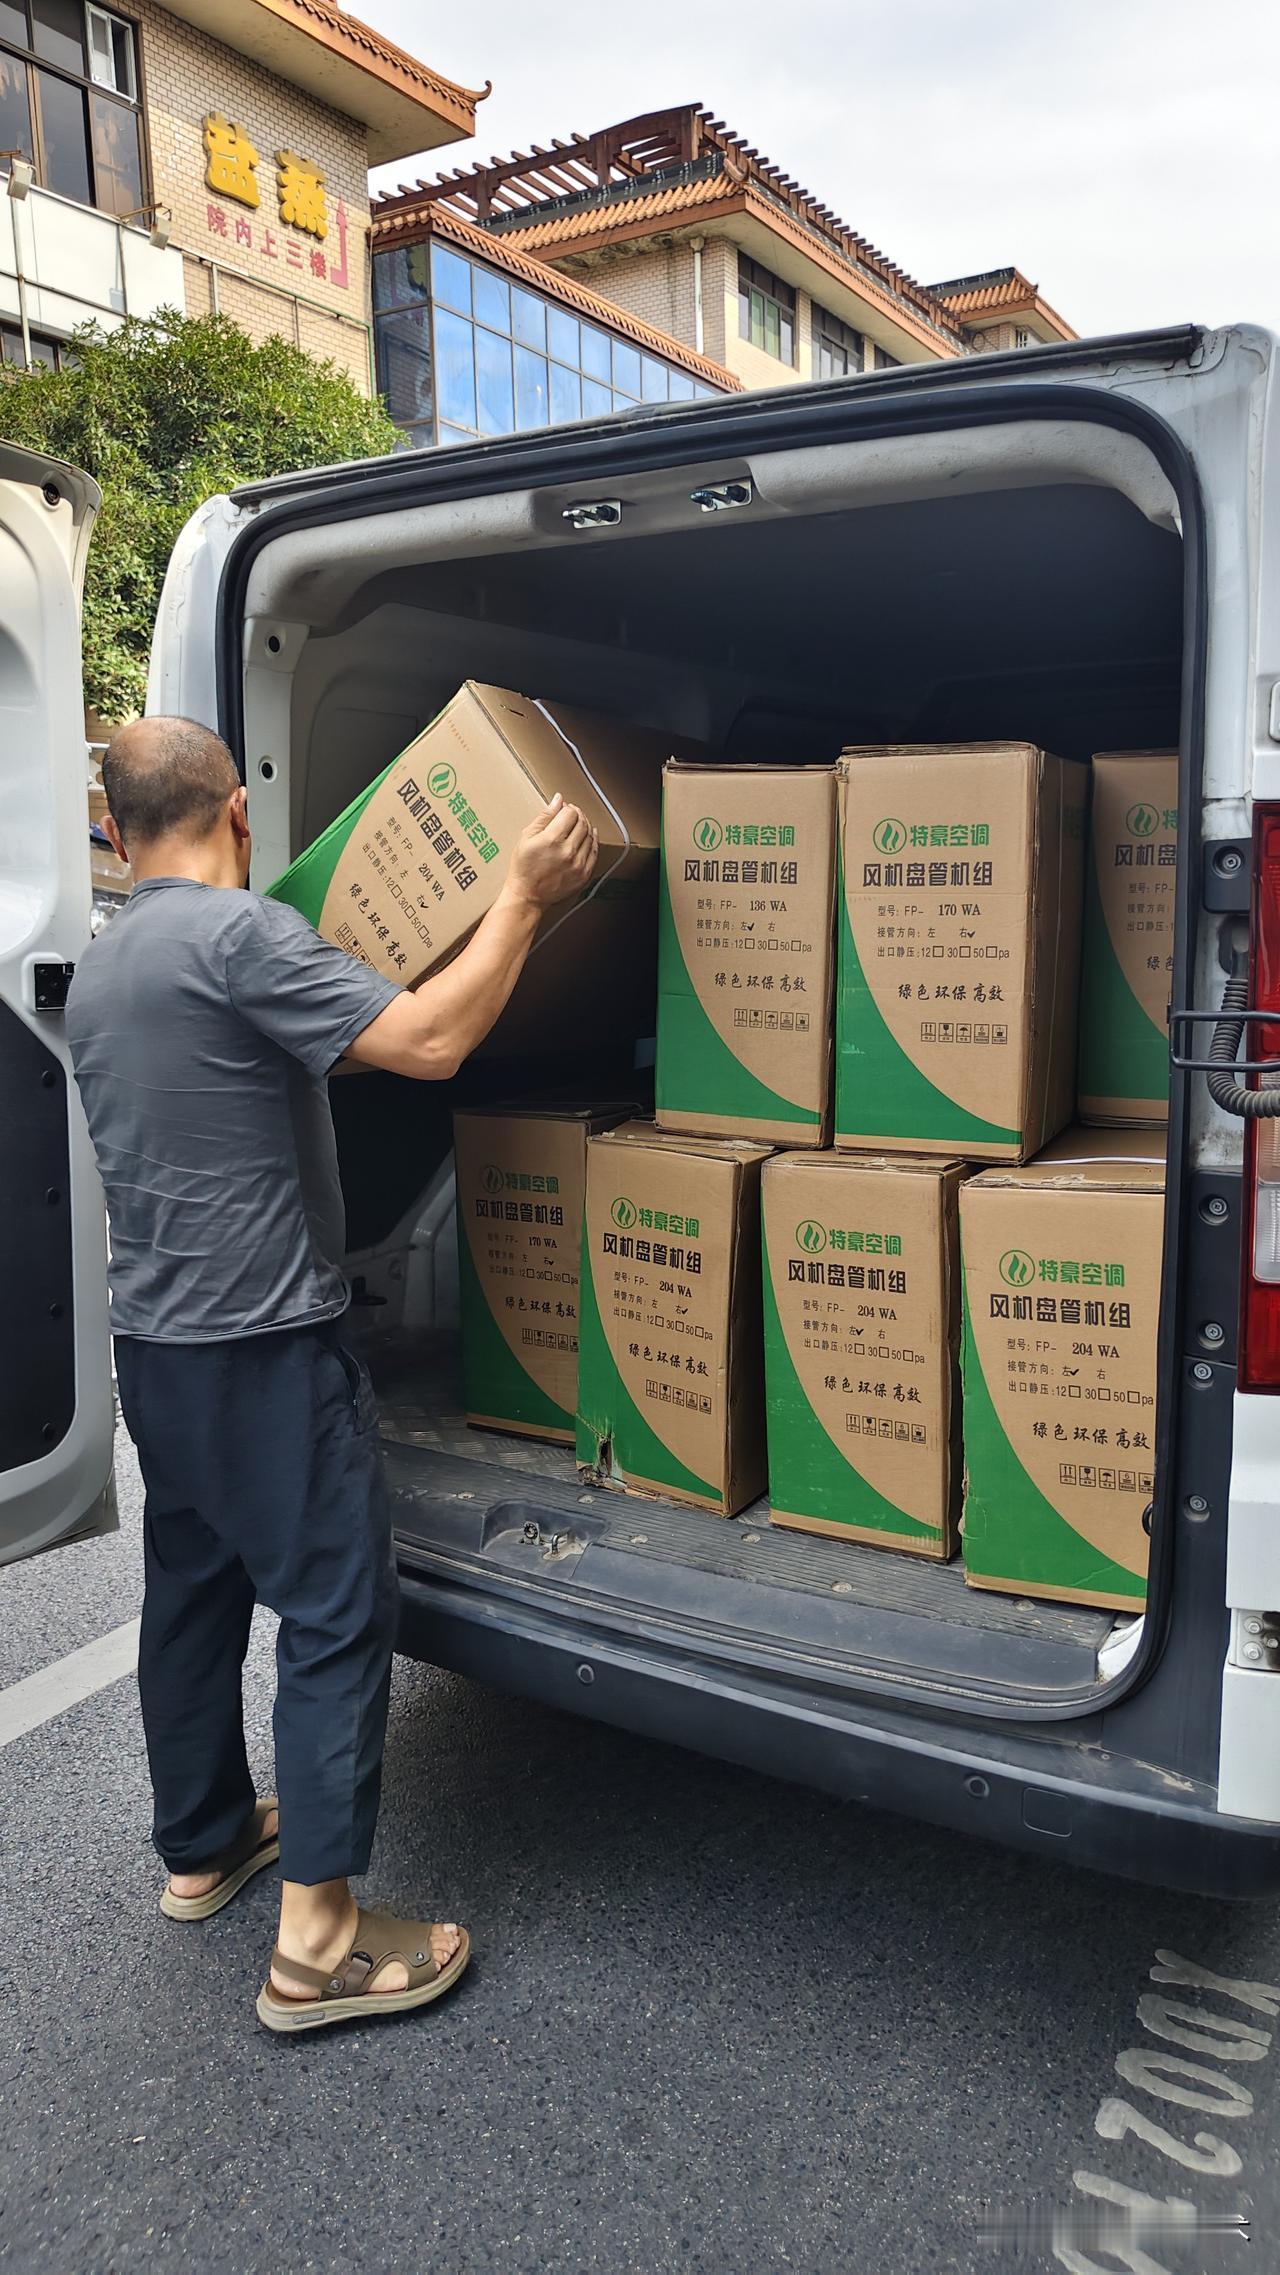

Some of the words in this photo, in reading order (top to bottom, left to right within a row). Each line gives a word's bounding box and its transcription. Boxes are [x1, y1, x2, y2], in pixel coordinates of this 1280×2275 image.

[207, 204, 327, 280] 院内上三楼
[397, 778, 478, 891] 风机盘管机组
[448, 791, 500, 864] 特豪空调
[726, 825, 794, 846] 特豪空调
[910, 824, 990, 847] 特豪空调
[418, 863, 434, 882] 204
[432, 881, 446, 902] WA
[684, 860, 798, 884] 风机盘管机组
[863, 862, 992, 886] 风机盘管机组
[750, 901, 766, 911] 136
[770, 901, 787, 912] WA
[939, 904, 956, 916] 170
[962, 904, 981, 916] WA
[350, 883, 408, 970] 绿色环保高效
[714, 972, 807, 992] 绿色环保高效
[898, 983, 1005, 1002] 绿色环保高效
[476, 1199, 563, 1226] 风机盘管机组
[639, 1208, 699, 1238] 特豪空调
[529, 1236, 541, 1246] 170
[544, 1238, 557, 1248] WA
[603, 1233, 701, 1274] 风机盘管机组
[829, 1229, 902, 1256] 特豪空调
[788, 1259, 906, 1294] 风机盘管机组
[1039, 1259, 1125, 1287] 特豪空调
[660, 1281, 674, 1293] 204
[678, 1285, 692, 1297] WA
[858, 1305, 875, 1317] 204
[879, 1308, 897, 1320] WA
[990, 1294, 1131, 1328] 风机盘管机组
[629, 1343, 709, 1377] 绿色环保高效
[1072, 1343, 1093, 1356] 204
[1098, 1345, 1120, 1358] WA
[824, 1376, 922, 1403] 绿色环保高效
[1032, 1422, 1150, 1450] 绿色环保高效
